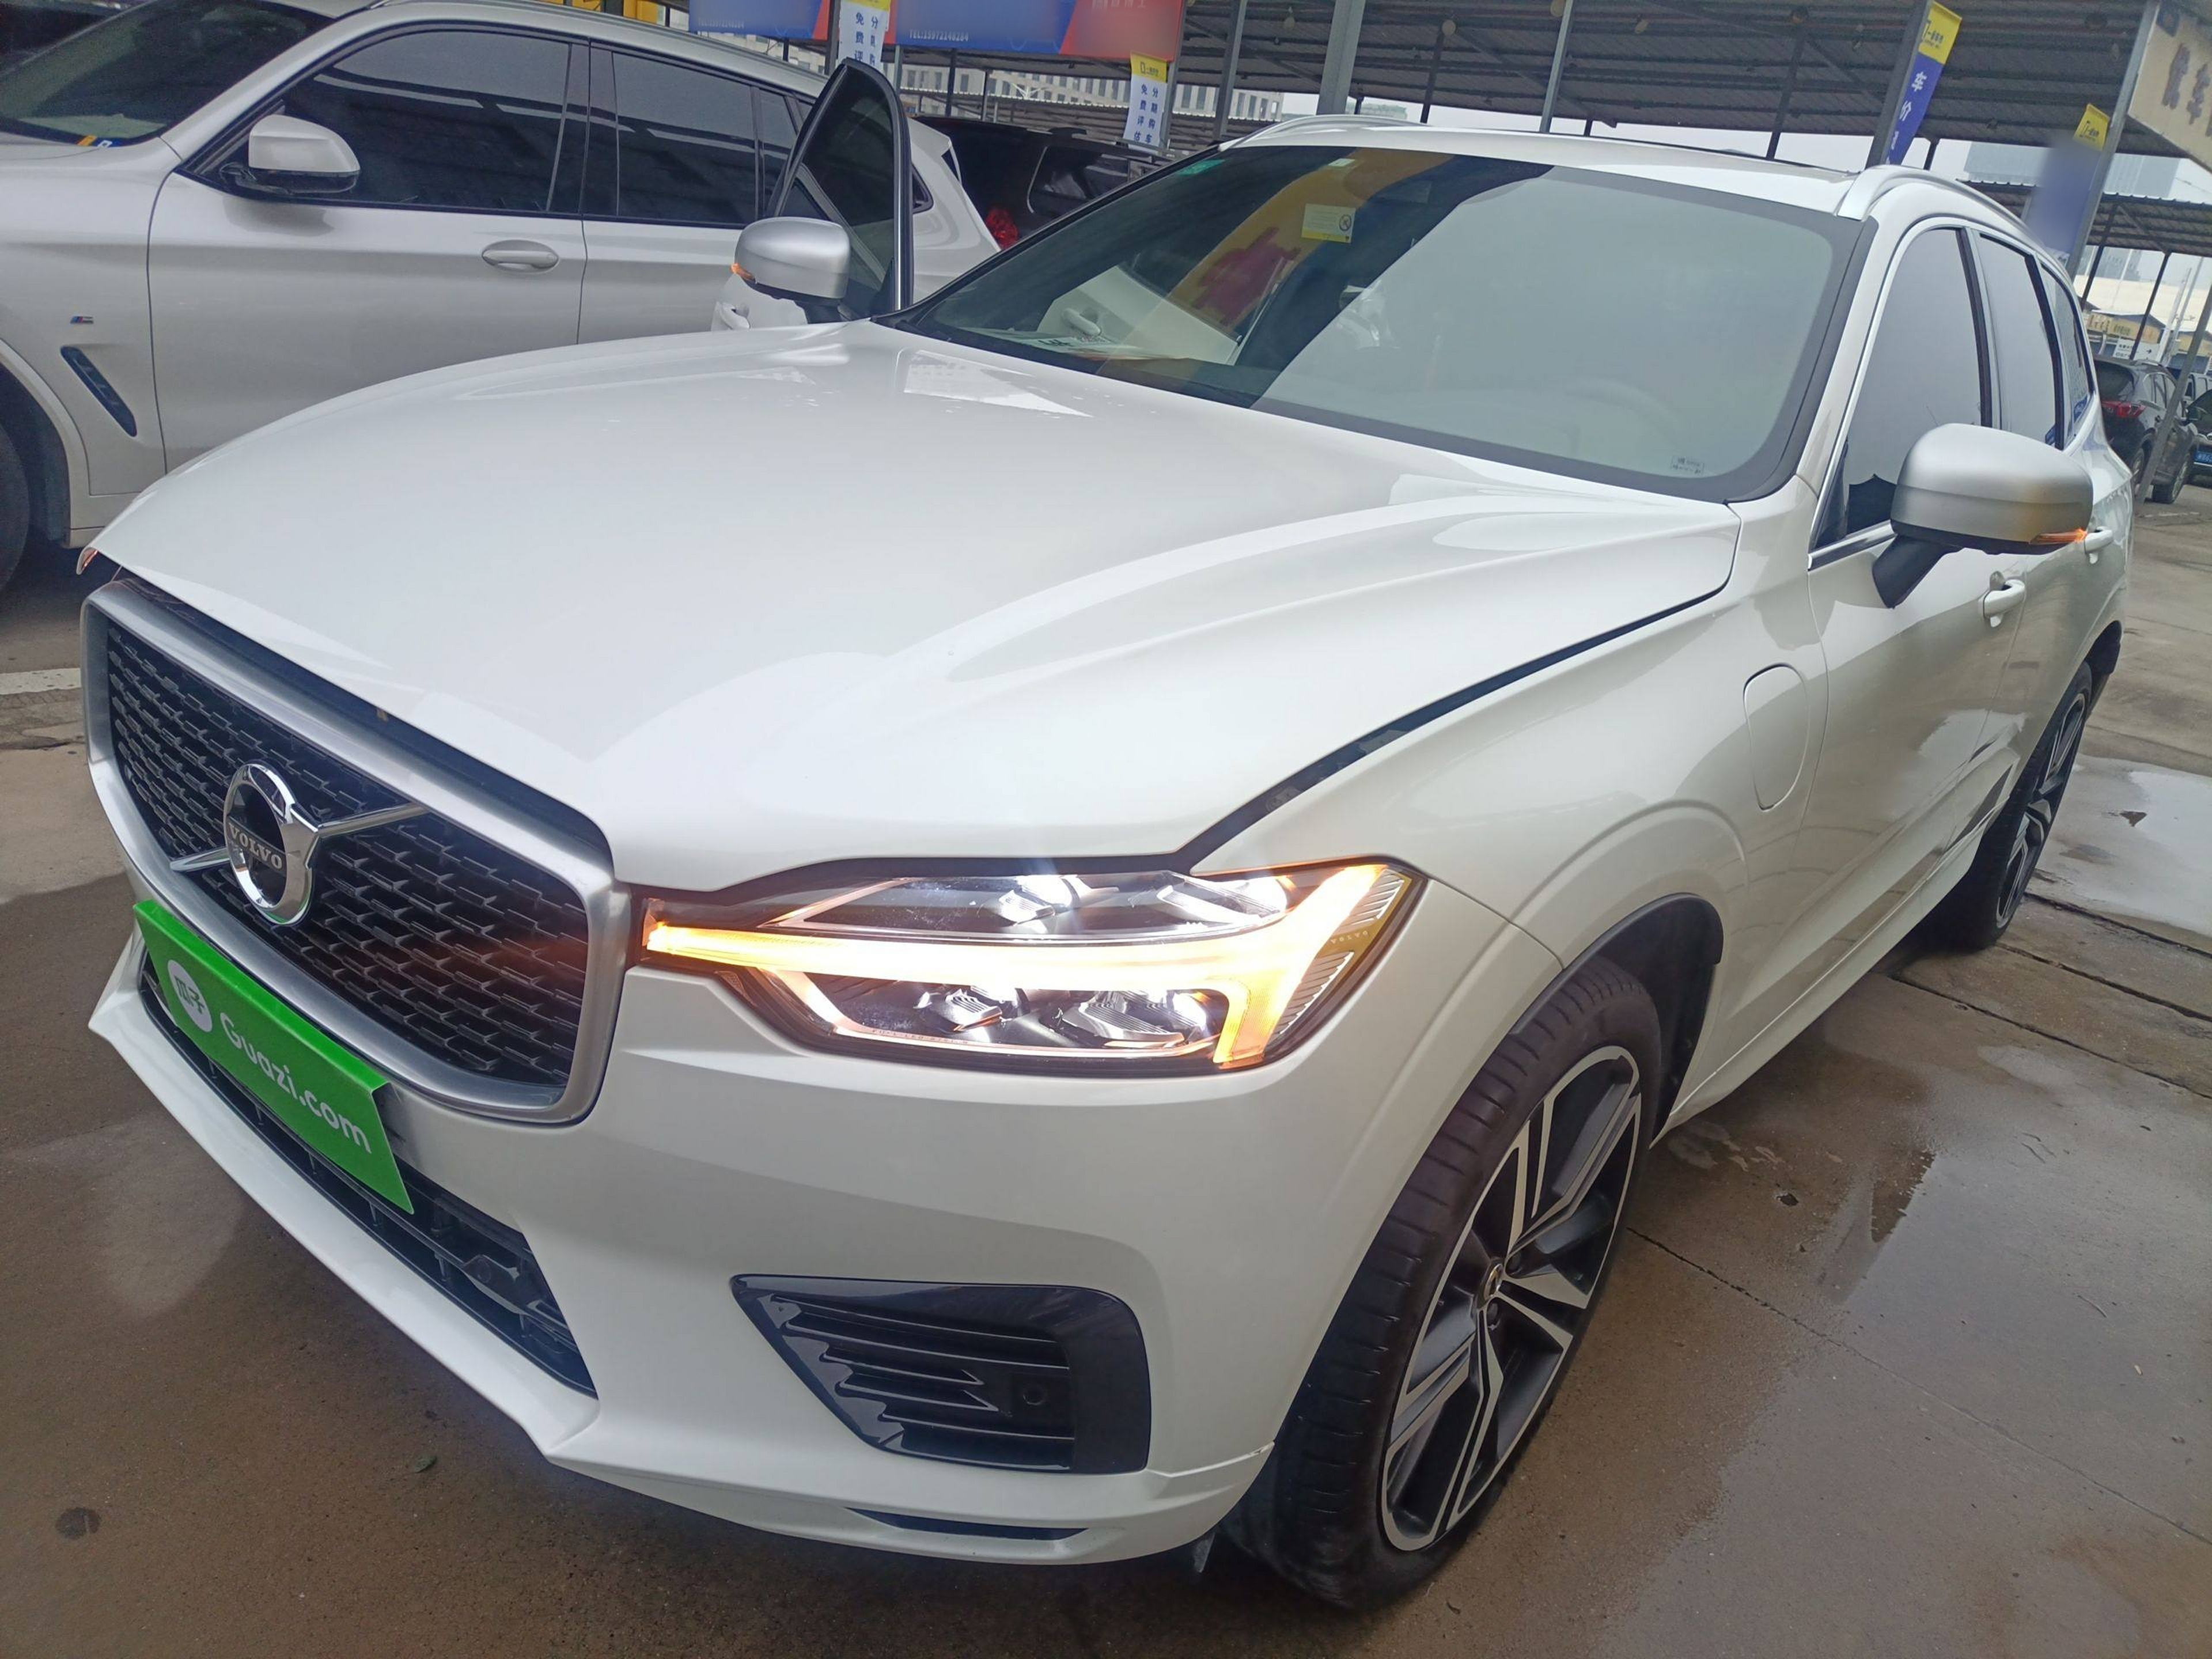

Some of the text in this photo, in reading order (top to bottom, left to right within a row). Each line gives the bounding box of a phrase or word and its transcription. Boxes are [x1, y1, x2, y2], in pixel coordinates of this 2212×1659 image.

[228, 822, 282, 869] VOLVO
[174, 975, 205, 1014] 瓜子
[220, 1012, 372, 1154] Guazi.com
